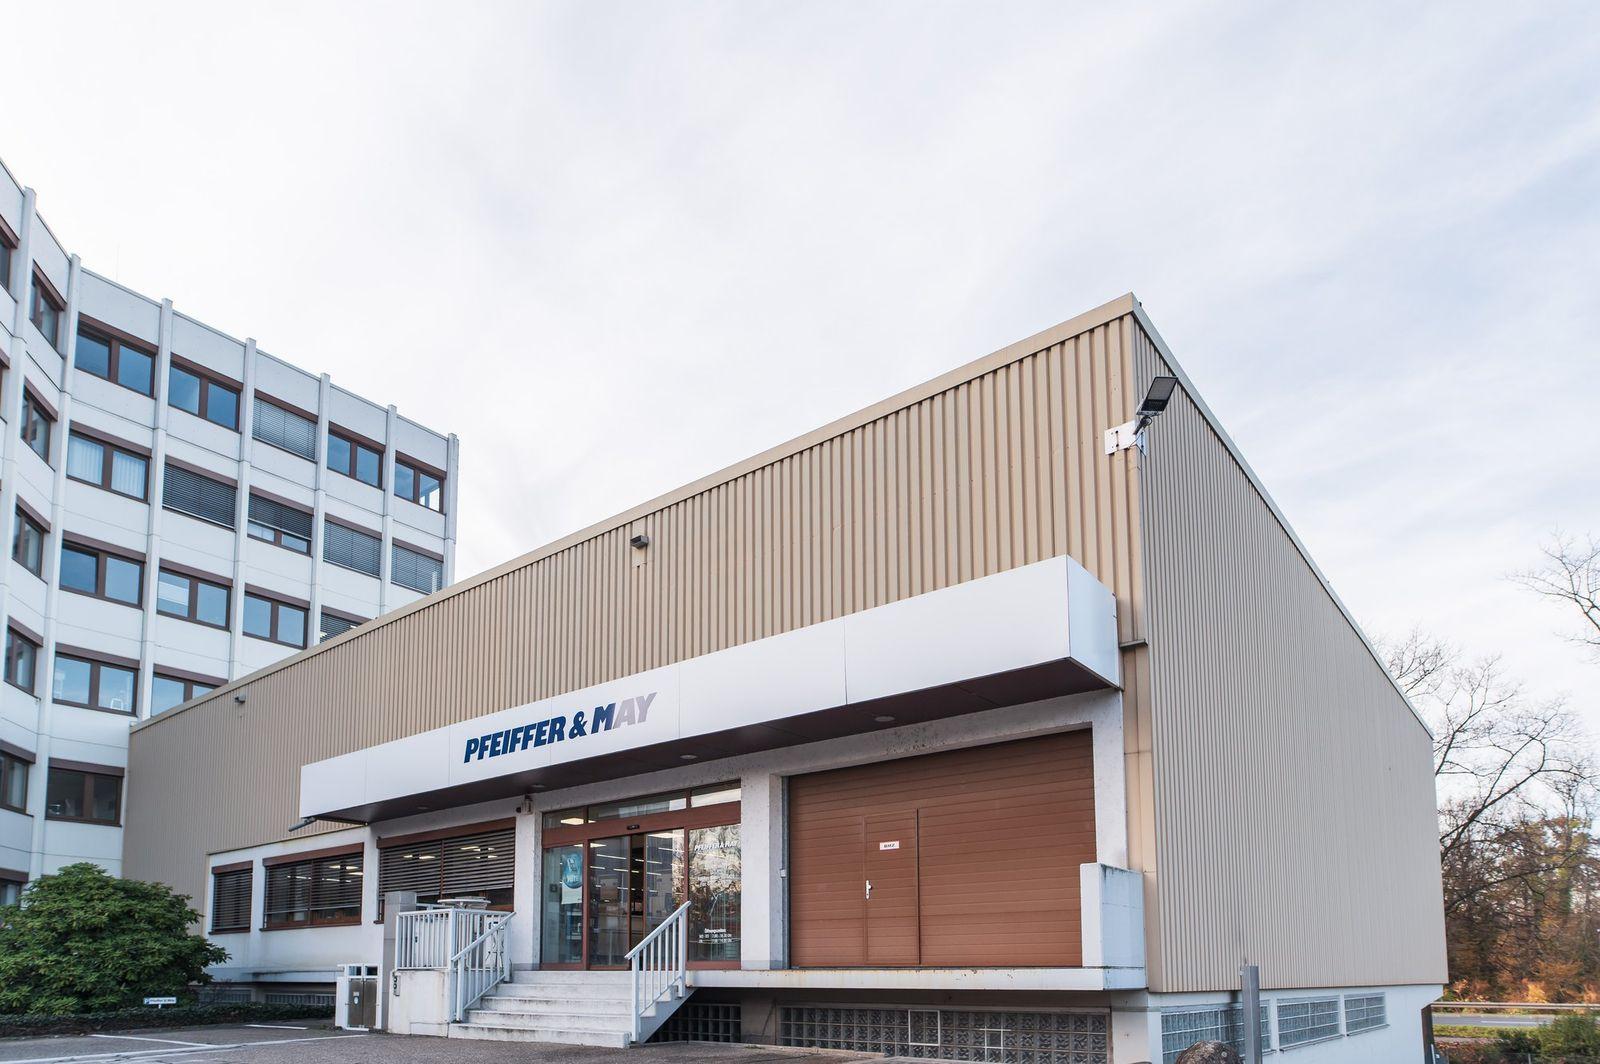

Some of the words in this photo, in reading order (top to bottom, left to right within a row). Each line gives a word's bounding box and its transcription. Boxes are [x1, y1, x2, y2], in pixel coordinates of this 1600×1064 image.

[463, 715, 566, 763] PFEIFFER
[568, 710, 588, 739] &
[591, 692, 657, 734] MAY
